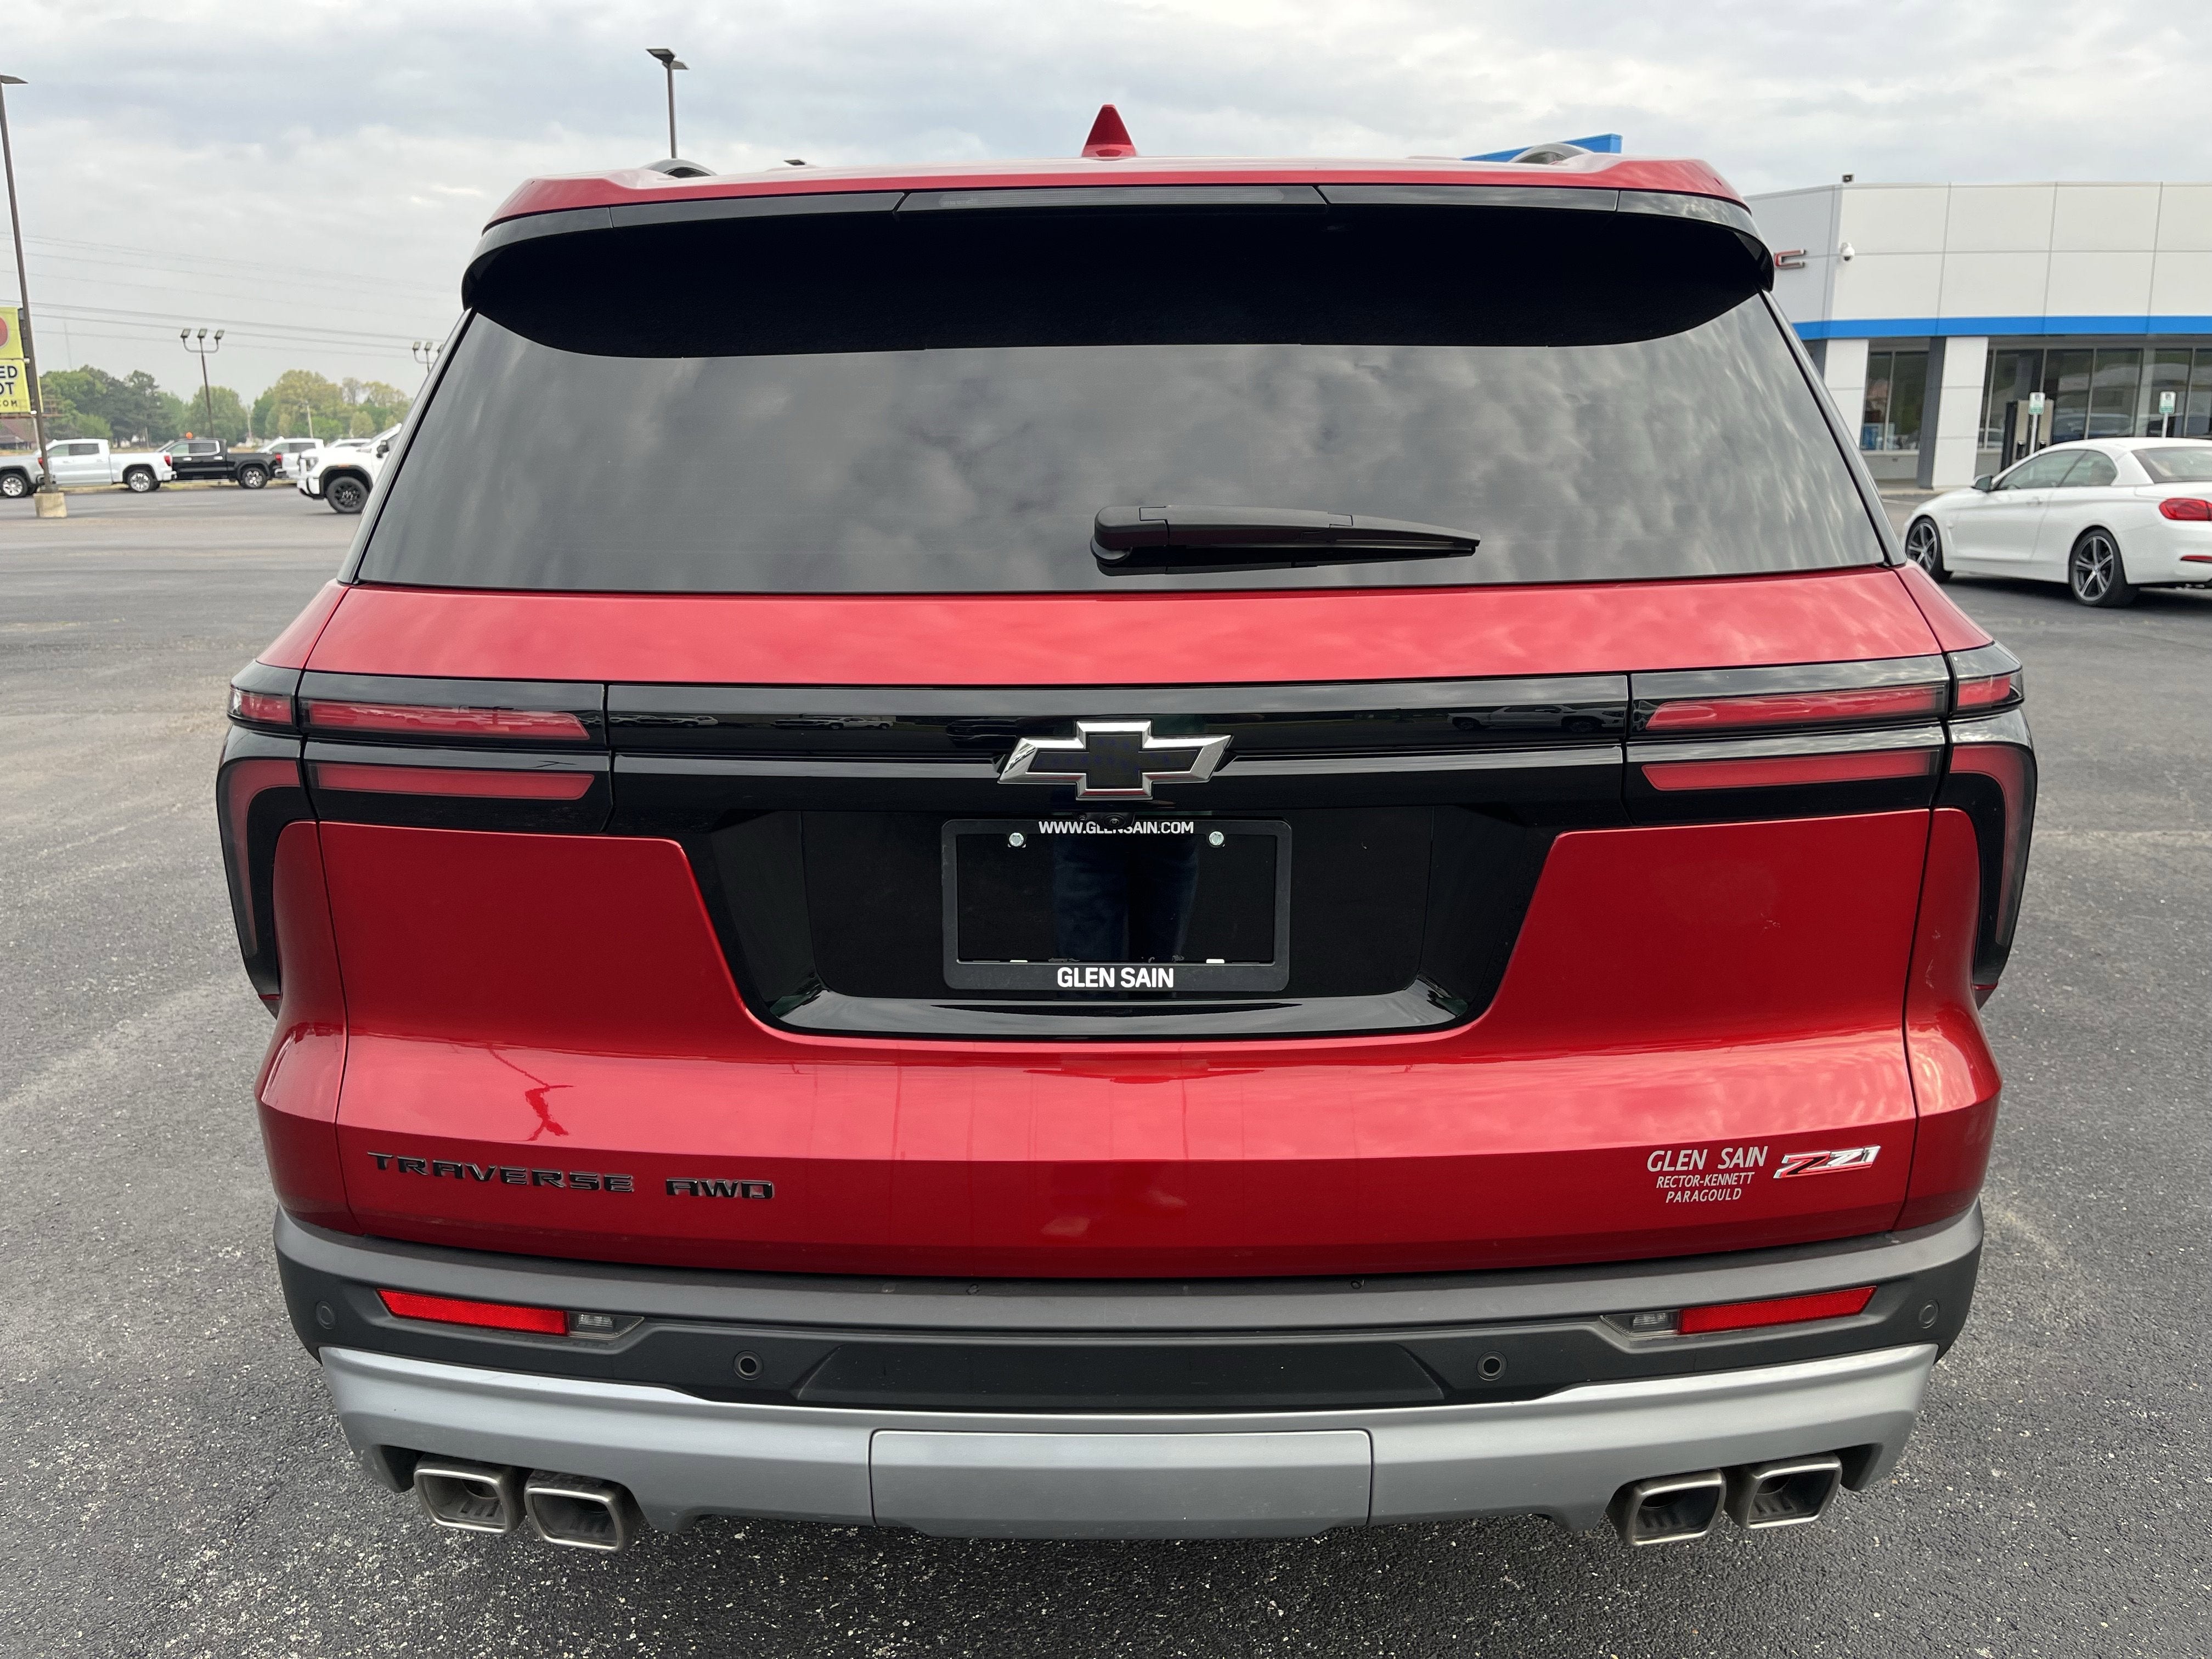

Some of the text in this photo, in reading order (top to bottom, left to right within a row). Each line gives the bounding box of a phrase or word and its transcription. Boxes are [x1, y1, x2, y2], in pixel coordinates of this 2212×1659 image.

[1057, 967, 1174, 988] GLEN SAIN
[1647, 1146, 1768, 1172] GLEN SAIN
[367, 1150, 775, 1200] TRAVERSE AWD
[1656, 1172, 1755, 1188] RECTOR-KENNETT
[1665, 1188, 1742, 1203] PARAGOULD
